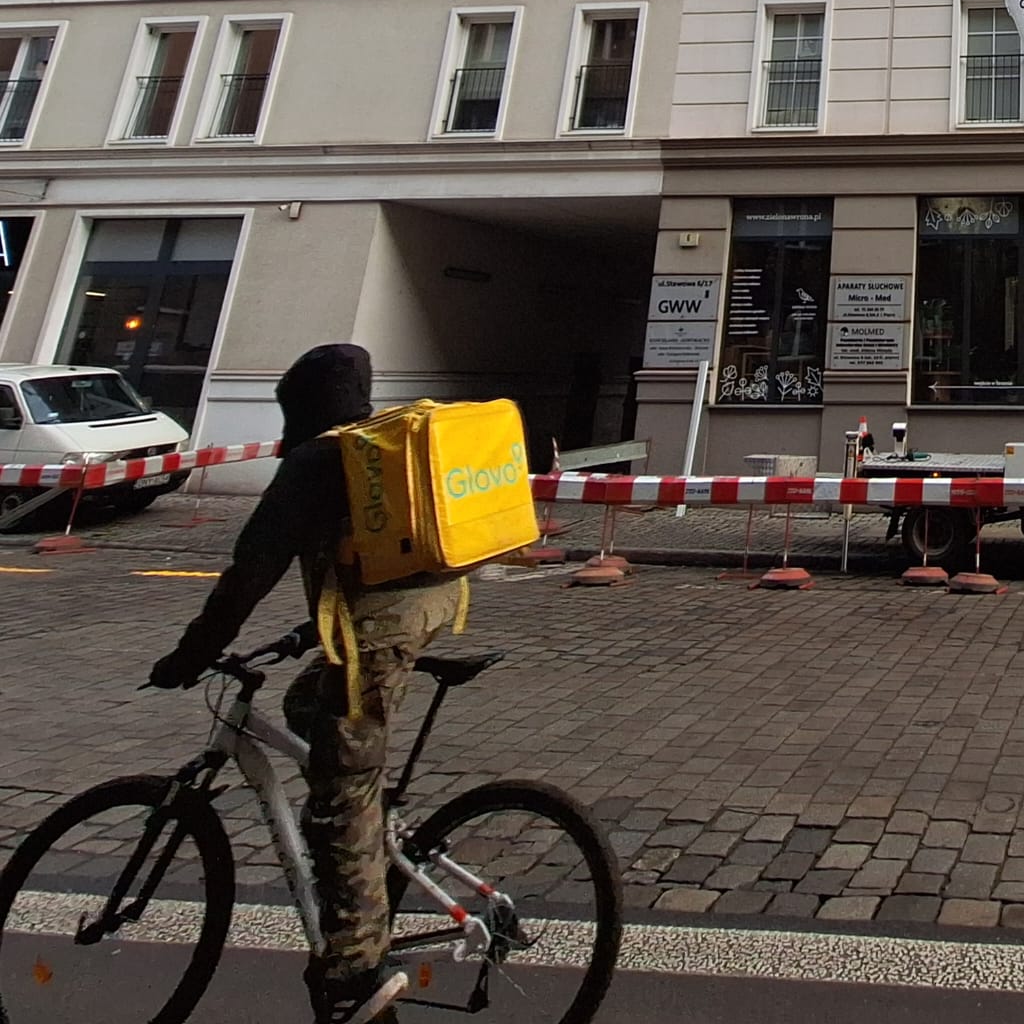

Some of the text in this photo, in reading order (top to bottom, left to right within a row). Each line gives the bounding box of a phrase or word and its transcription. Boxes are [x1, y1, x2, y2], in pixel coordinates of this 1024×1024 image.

[837, 282, 866, 290] APARATY
[848, 294, 869, 302] Micro
[875, 294, 892, 302] Med
[658, 299, 702, 314] GWW
[851, 328, 885, 336] MOLMED
